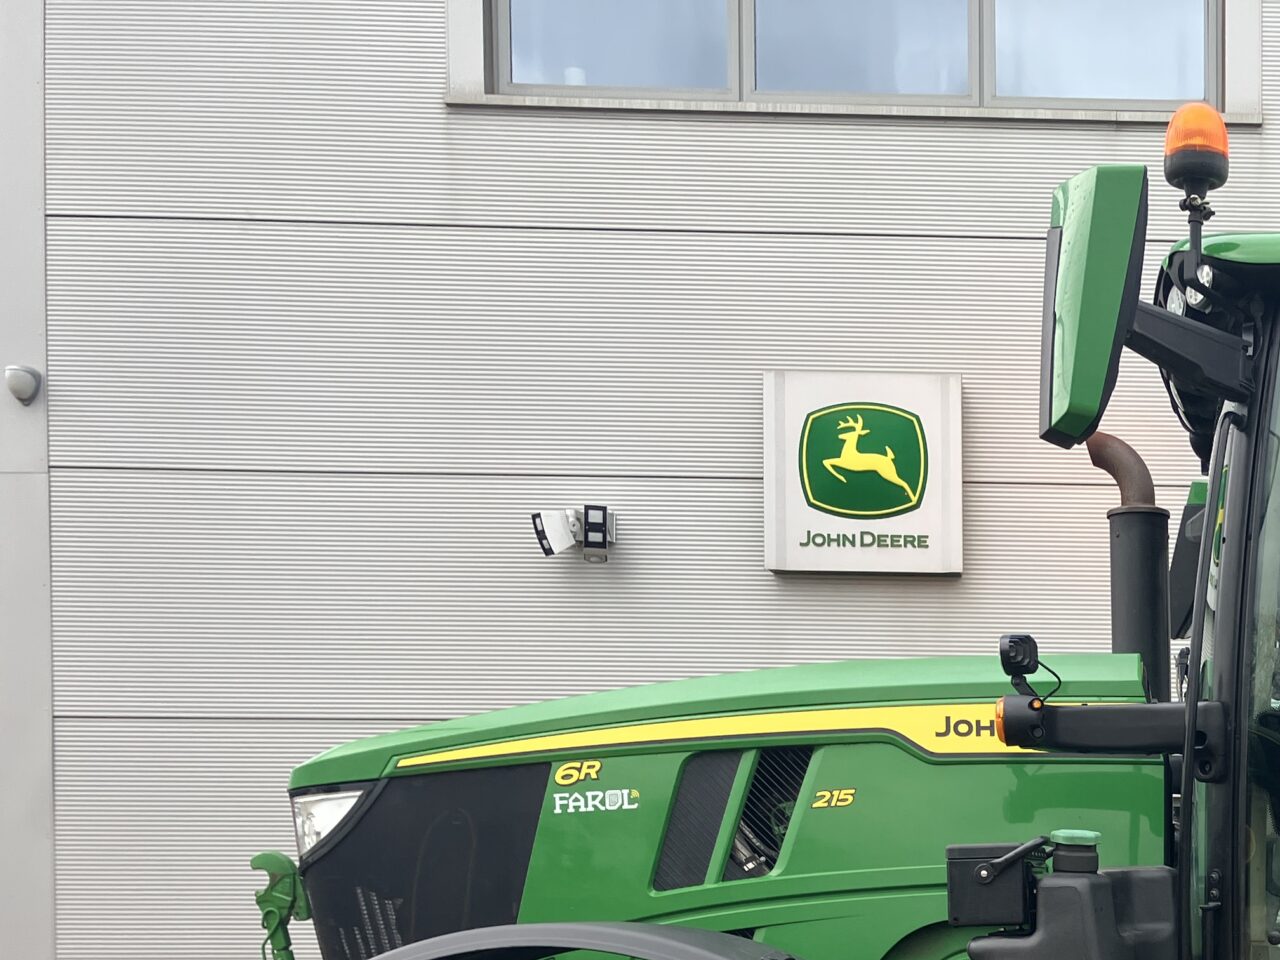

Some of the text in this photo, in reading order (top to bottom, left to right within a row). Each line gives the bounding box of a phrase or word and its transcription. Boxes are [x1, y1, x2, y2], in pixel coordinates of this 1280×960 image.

[800, 530, 929, 548] JOHN DEERE
[935, 716, 995, 737] JOH
[554, 759, 602, 786] 6R
[553, 789, 638, 814] FAROL
[811, 788, 856, 808] 215
